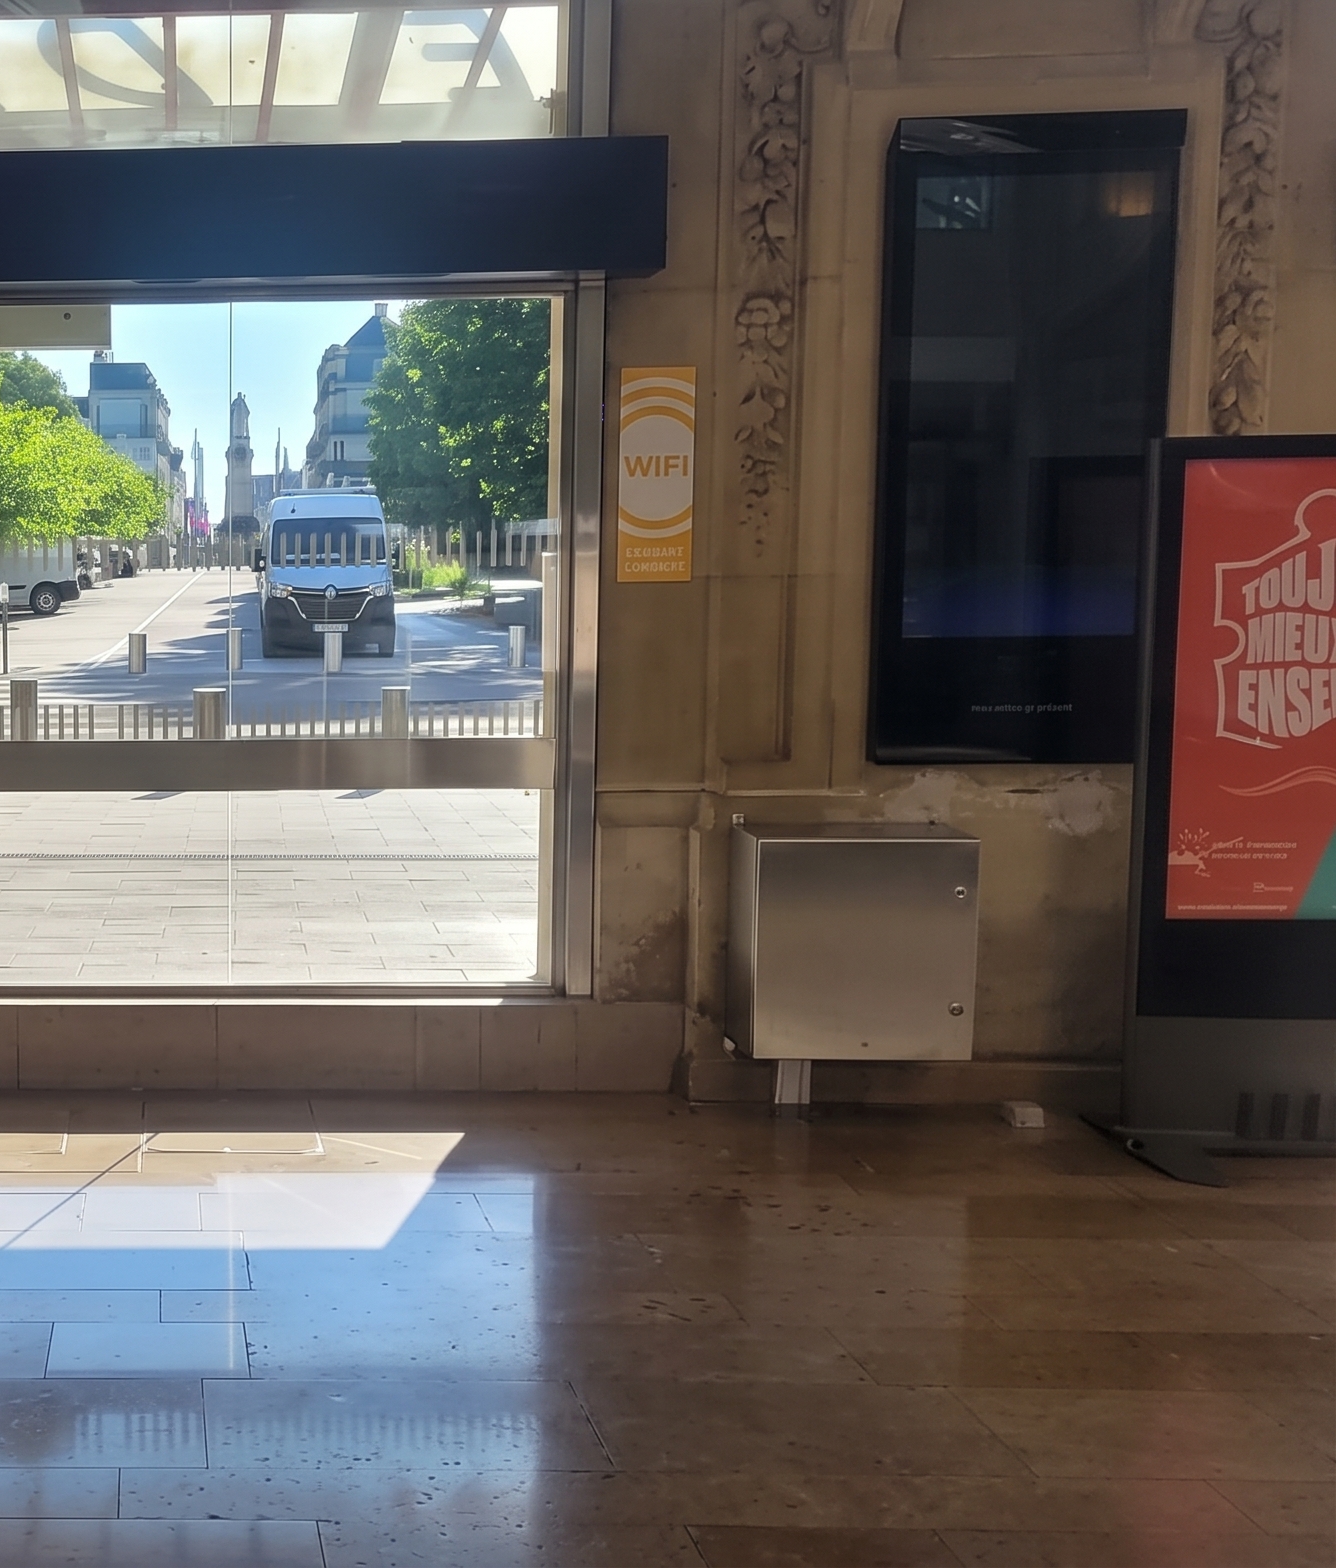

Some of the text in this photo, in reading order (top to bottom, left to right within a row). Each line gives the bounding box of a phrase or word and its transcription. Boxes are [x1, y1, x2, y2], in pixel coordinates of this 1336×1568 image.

[623, 455, 689, 478] WIFI
[1242, 538, 1336, 616] TOUJ
[1237, 666, 1336, 738] ENSE
